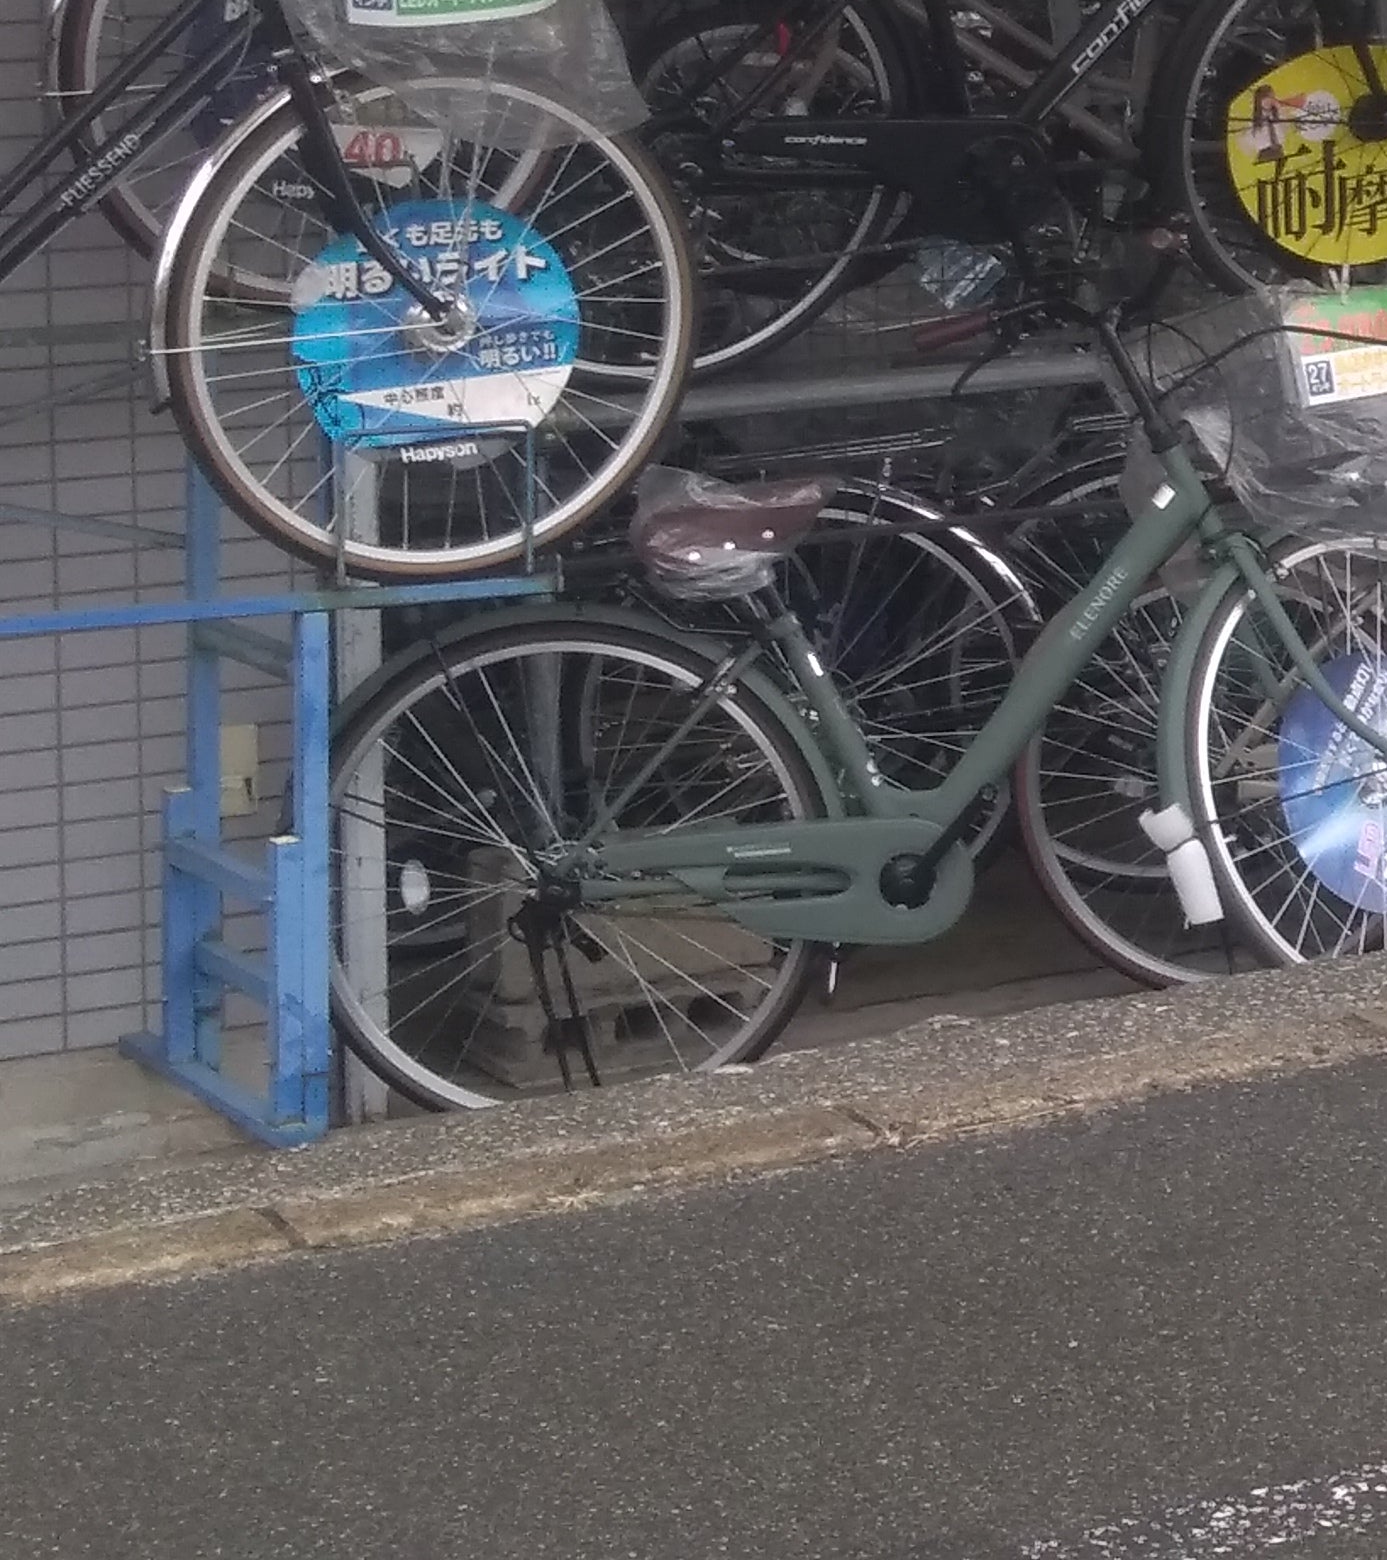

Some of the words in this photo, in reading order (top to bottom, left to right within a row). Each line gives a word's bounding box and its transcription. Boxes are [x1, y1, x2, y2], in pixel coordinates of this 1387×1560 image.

[60, 133, 140, 207] FLIESSEND
[356, 219, 503, 253] くも足元も
[401, 441, 479, 464] Hapyson
[1069, 566, 1129, 640] ELENORE
